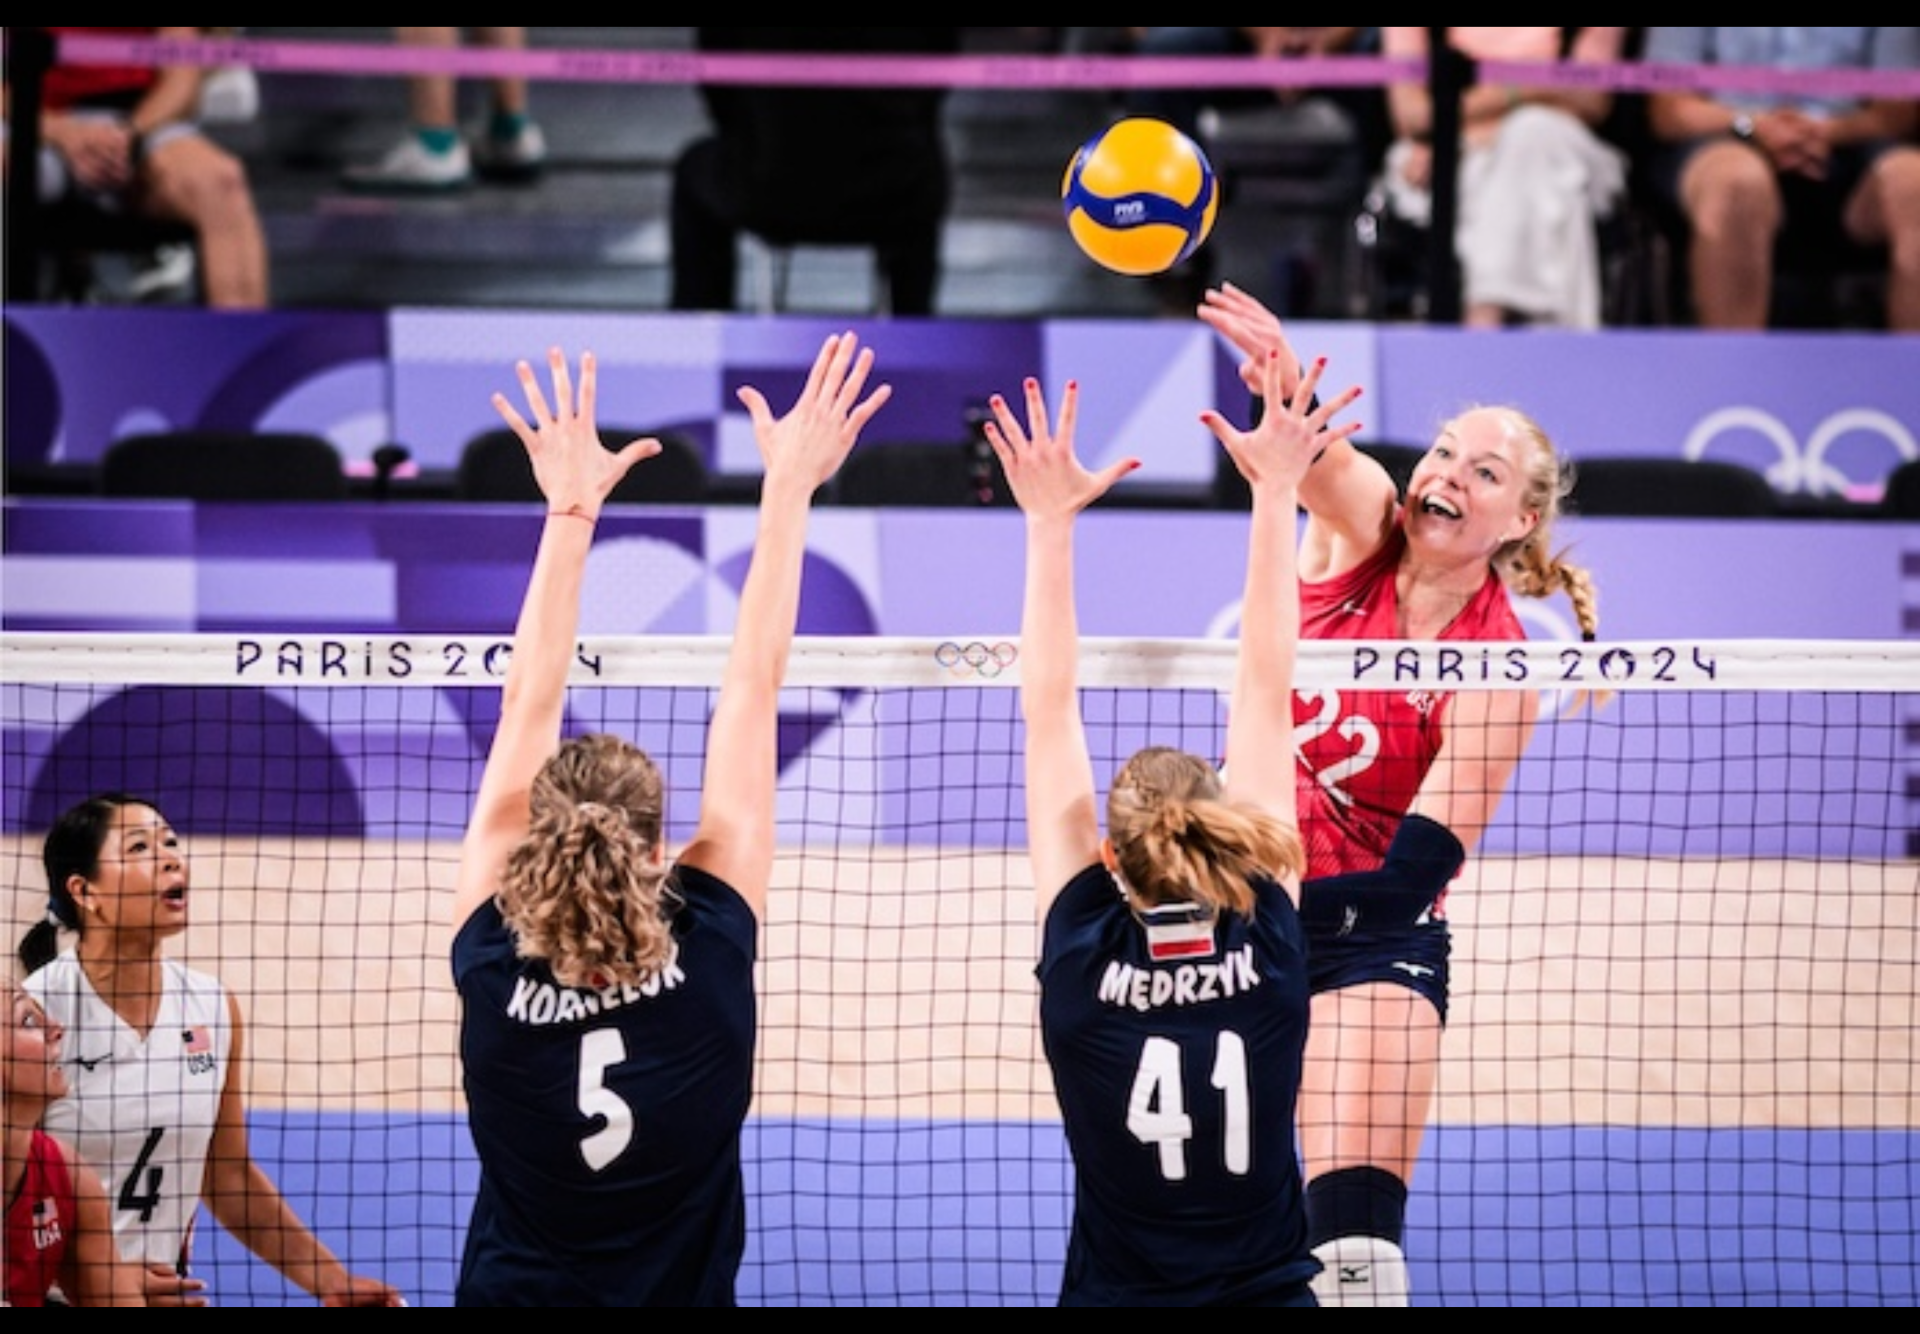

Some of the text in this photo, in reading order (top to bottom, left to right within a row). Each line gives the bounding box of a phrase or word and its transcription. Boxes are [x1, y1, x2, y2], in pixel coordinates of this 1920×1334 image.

[442, 641, 601, 677] 204
[1559, 646, 1716, 682] 2024
[1098, 942, 1260, 1012] MĘDRZYK
[187, 1053, 217, 1076] USA
[578, 1027, 634, 1171] 5
[1126, 1029, 1250, 1180] 41
[118, 1127, 164, 1223] 4
[32, 1220, 62, 1249] USA
